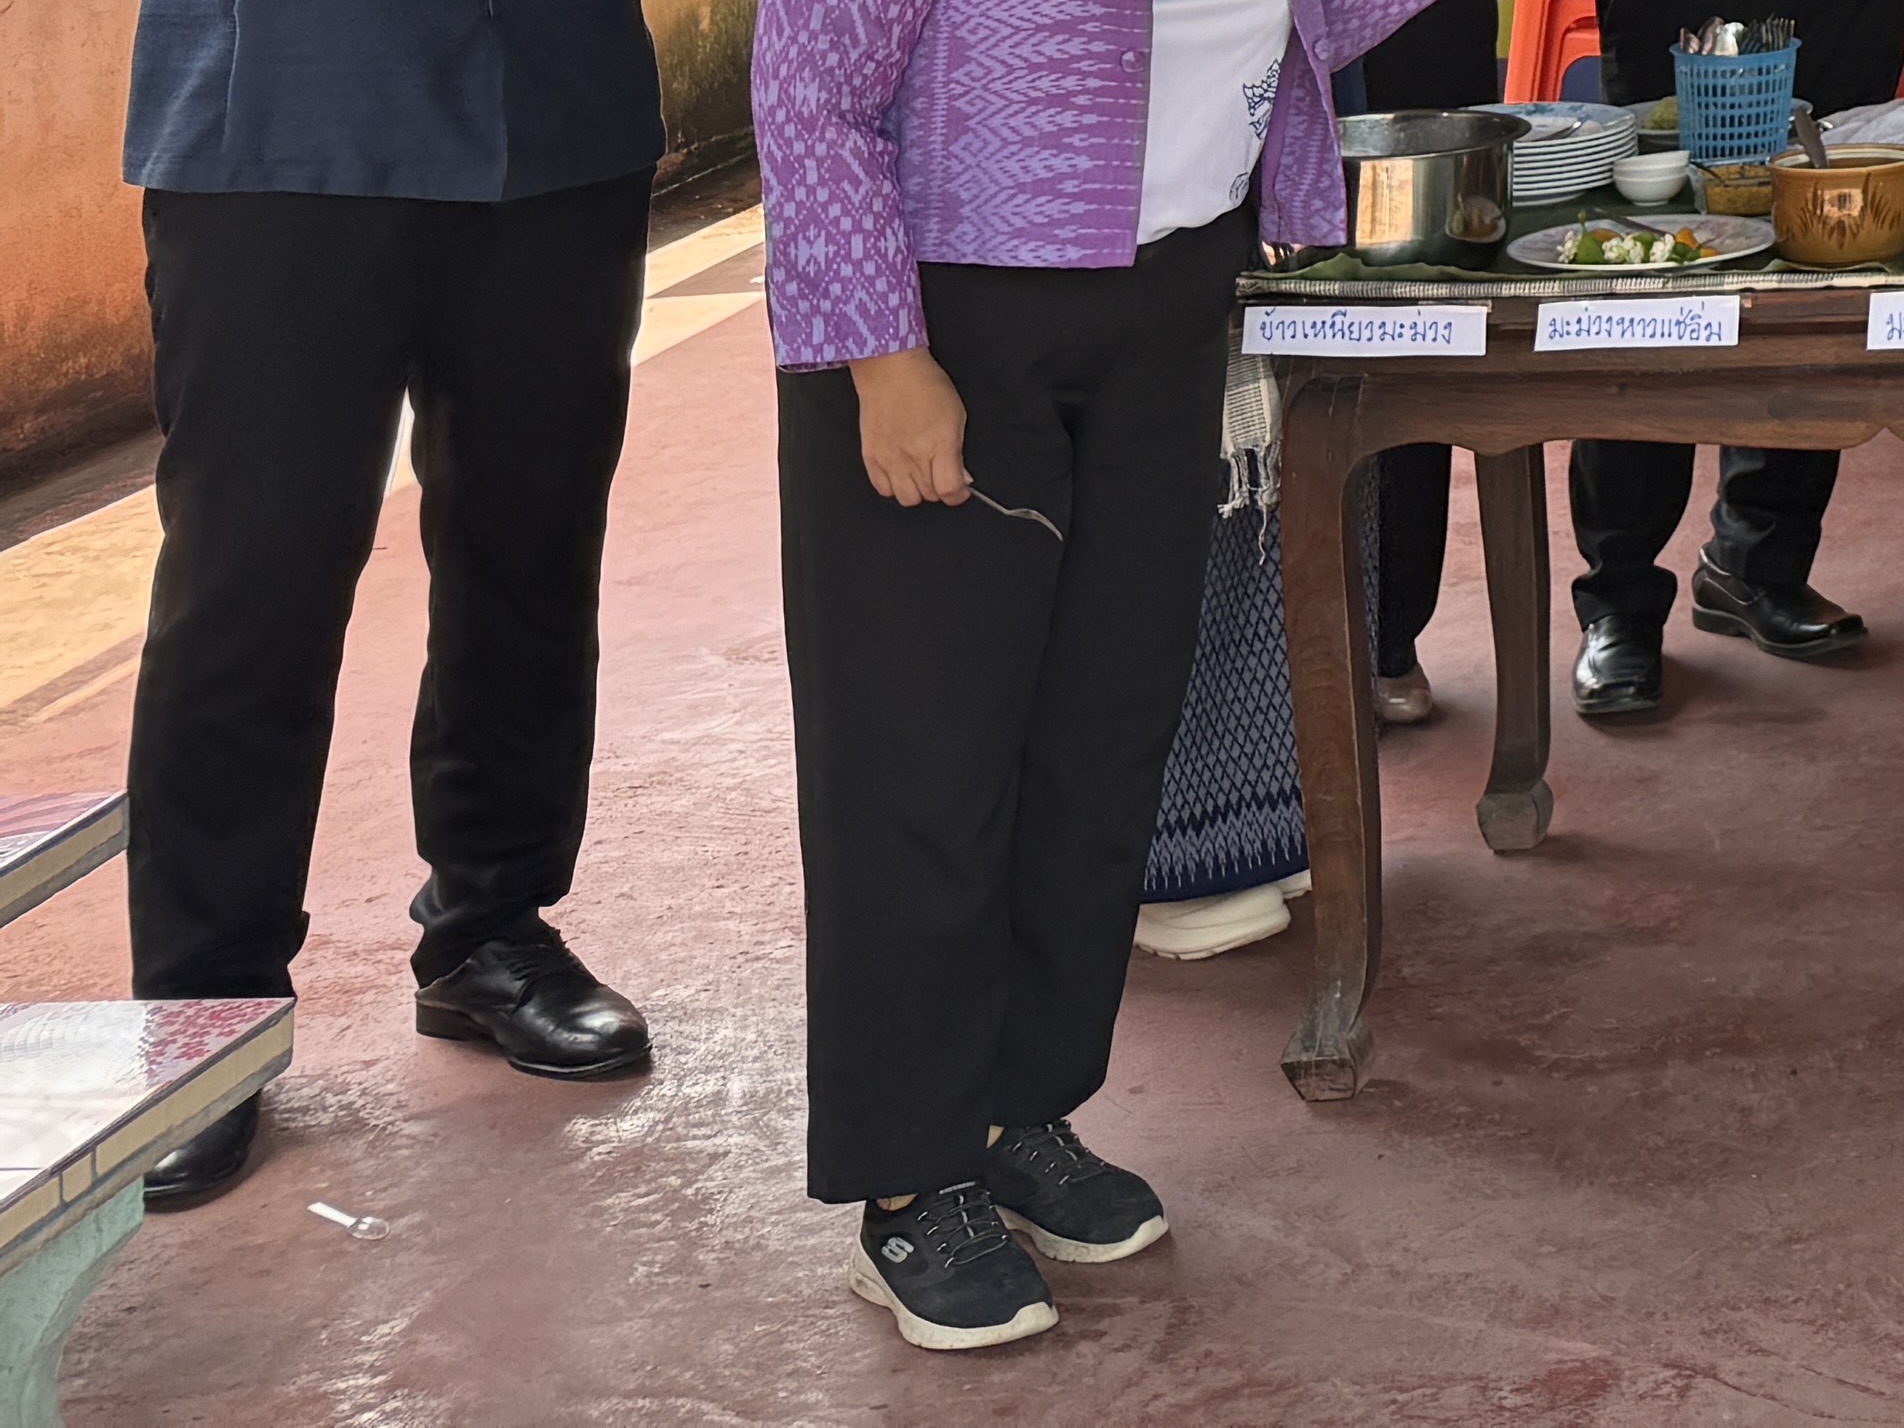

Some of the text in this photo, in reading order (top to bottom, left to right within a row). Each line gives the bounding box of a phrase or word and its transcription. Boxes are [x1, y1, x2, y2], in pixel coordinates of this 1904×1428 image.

[1260, 307, 1453, 344] ข้าวเหนียวมะม่วง
[1548, 301, 1722, 342] มะม่วงหาวแช่อิ่ม
